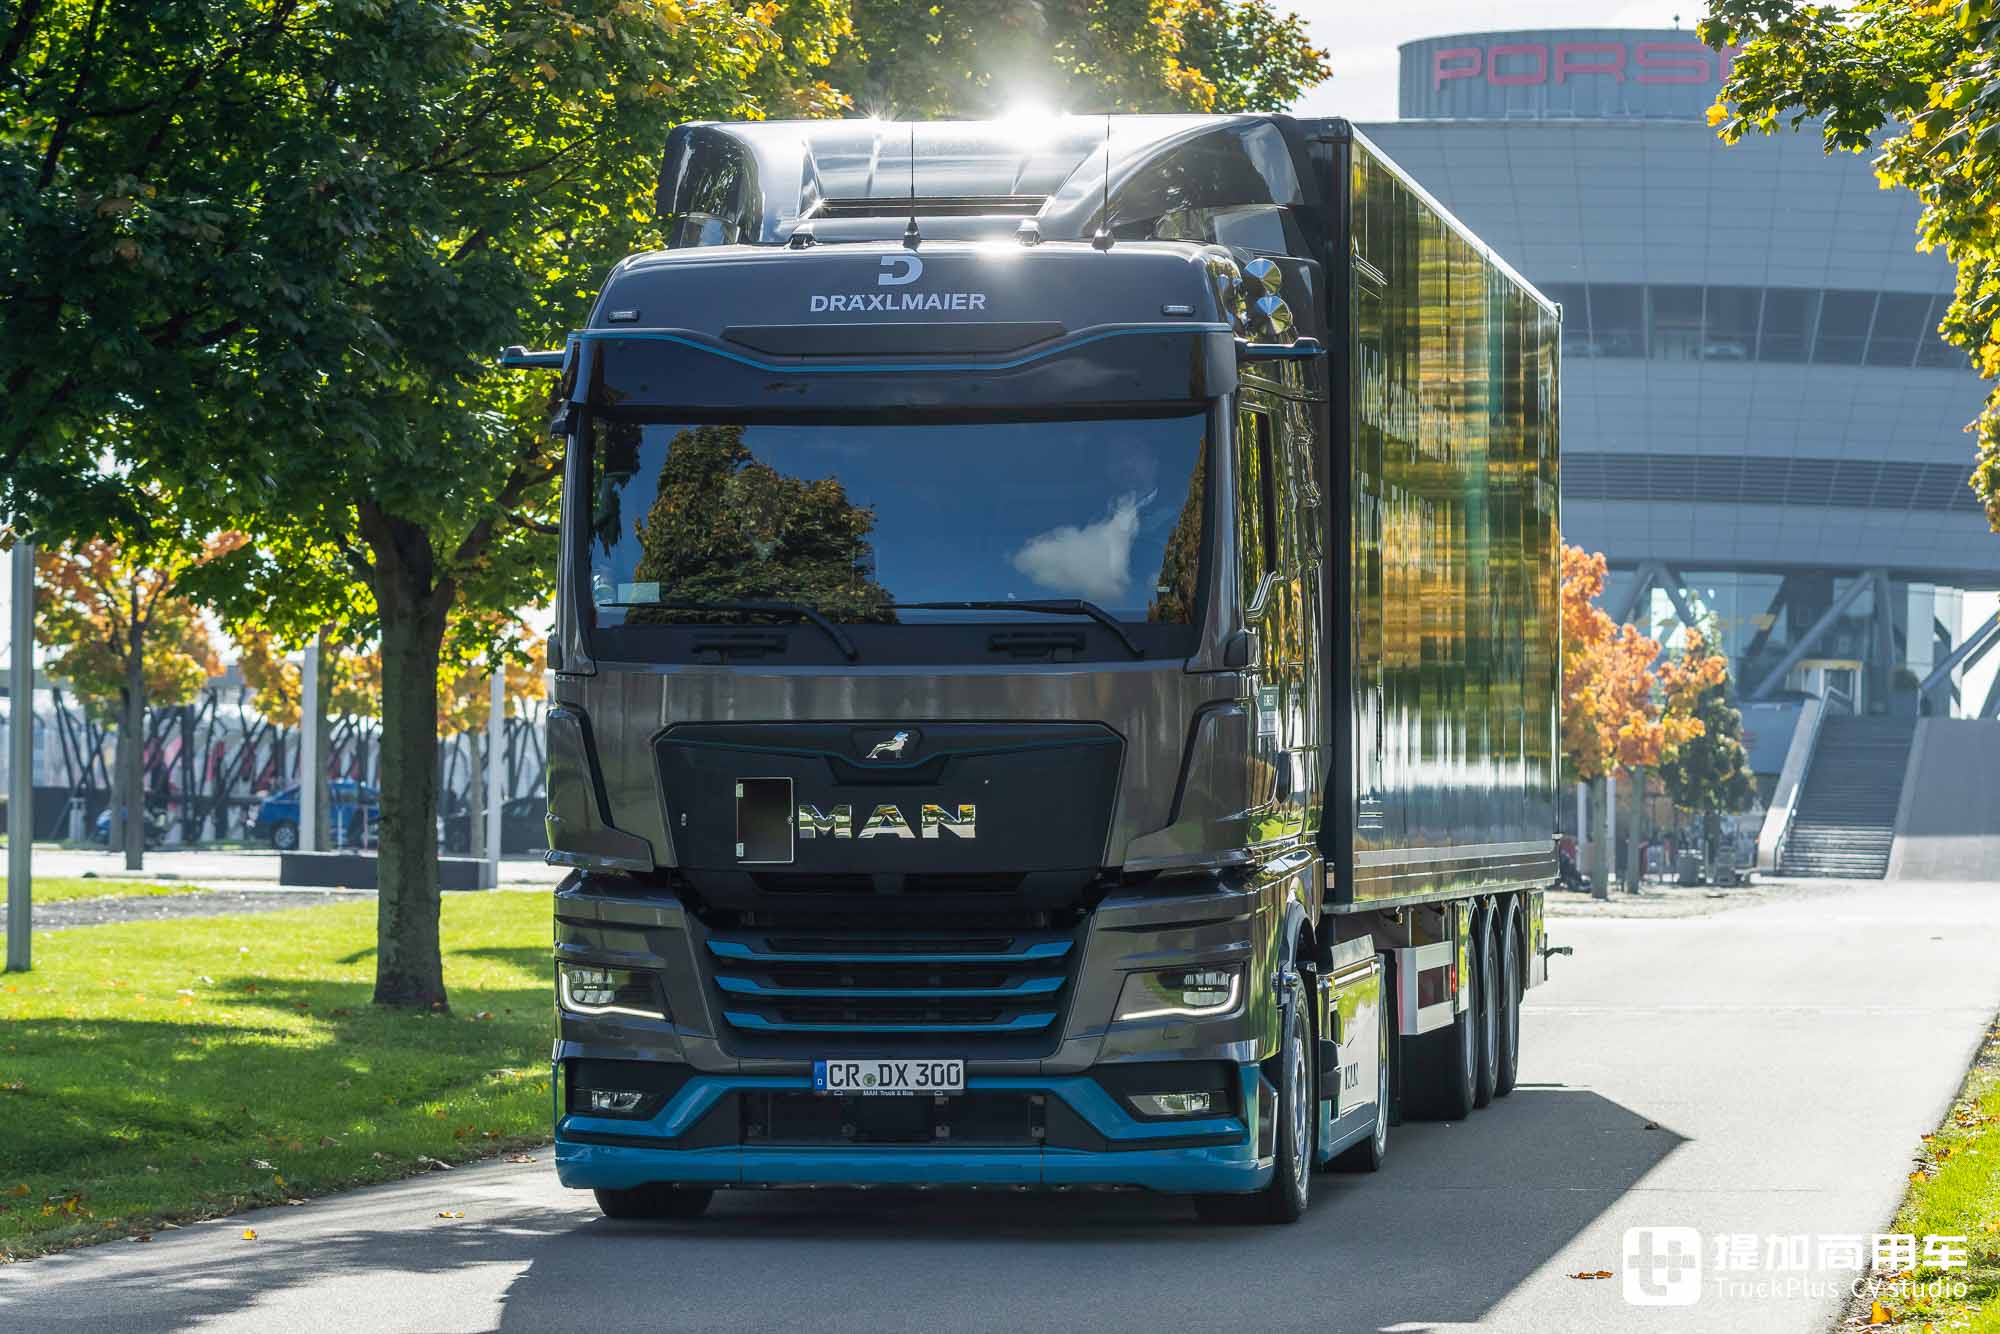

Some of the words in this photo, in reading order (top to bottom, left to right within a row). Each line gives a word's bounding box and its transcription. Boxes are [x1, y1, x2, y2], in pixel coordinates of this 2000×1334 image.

[1434, 43, 1743, 92] PORS
[810, 293, 986, 312] DRÄXLMAIER
[799, 804, 976, 838] MAN
[829, 1063, 860, 1087] CR
[878, 1063, 909, 1087] DX
[916, 1063, 961, 1087] 300
